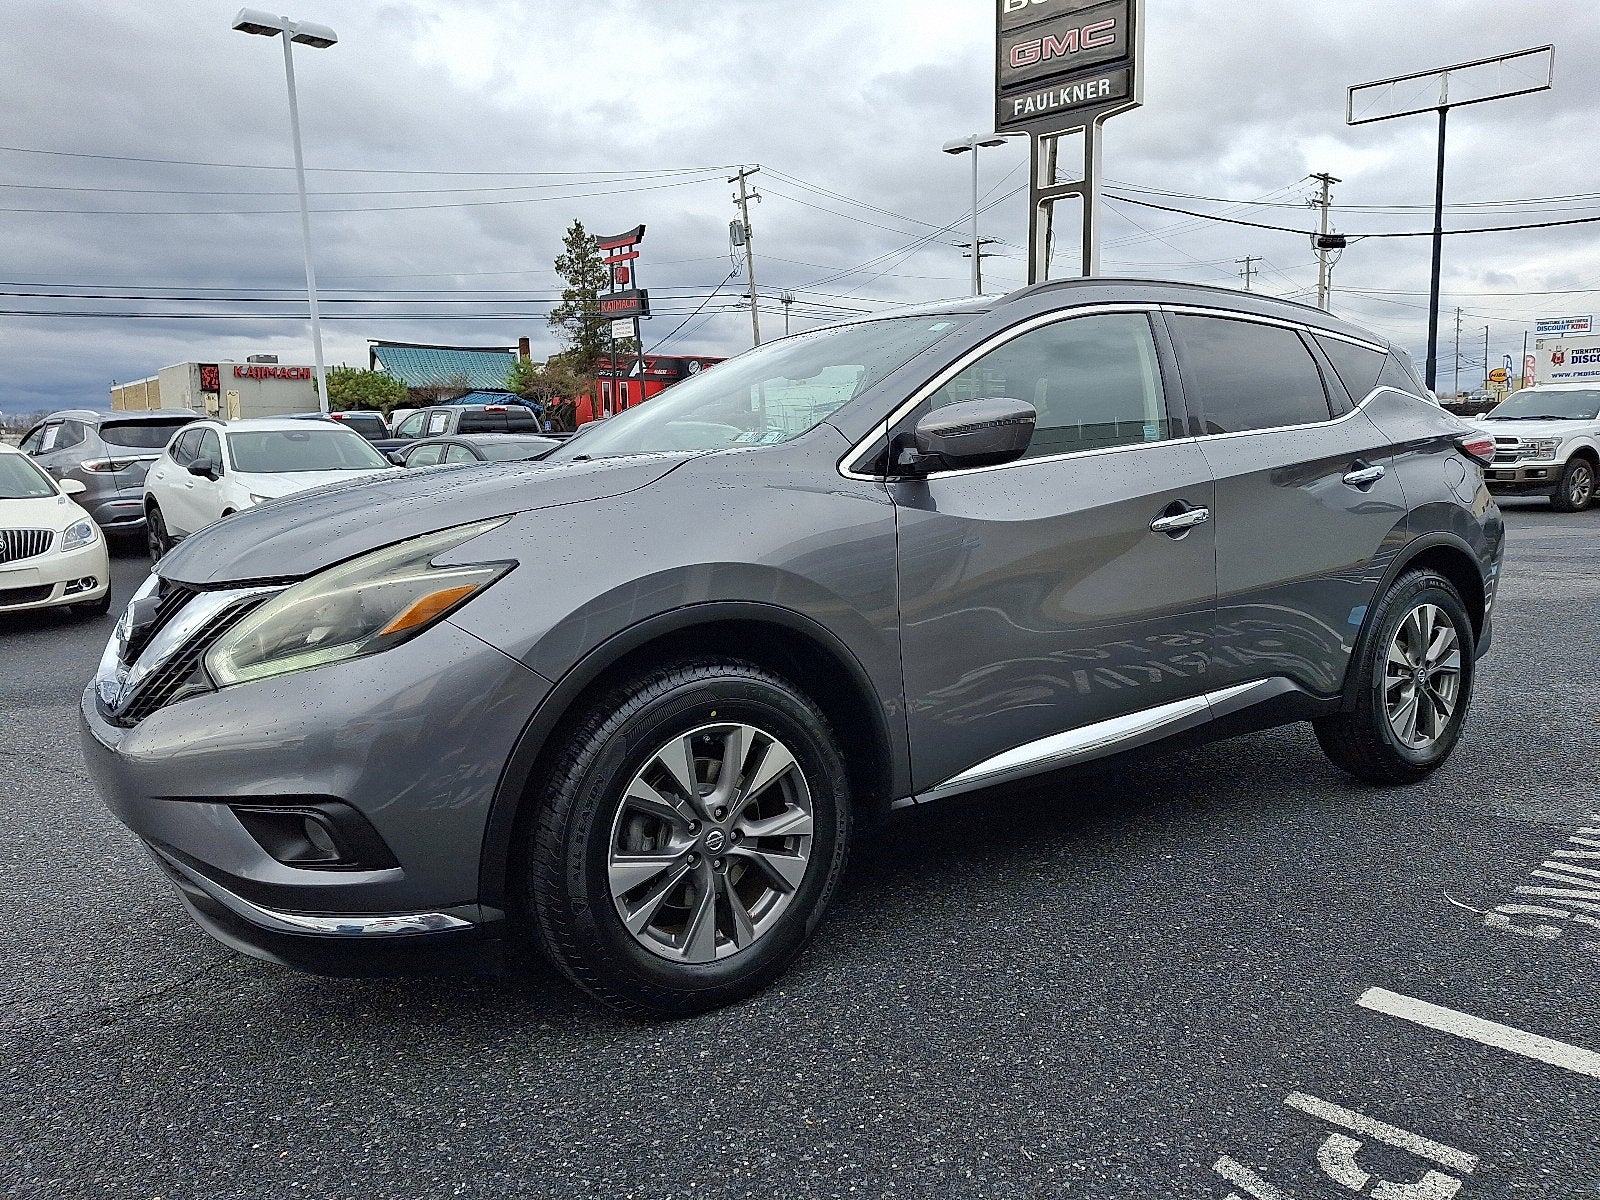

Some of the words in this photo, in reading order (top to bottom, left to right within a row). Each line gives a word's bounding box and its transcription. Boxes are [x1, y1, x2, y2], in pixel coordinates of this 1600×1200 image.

[1010, 18, 1115, 67] GMC
[1014, 78, 1110, 115] FAULKNER
[601, 296, 637, 313] KAJIMACHI
[1537, 324, 1569, 332] DISCOUNT
[233, 365, 312, 380] KAJIMACHI
